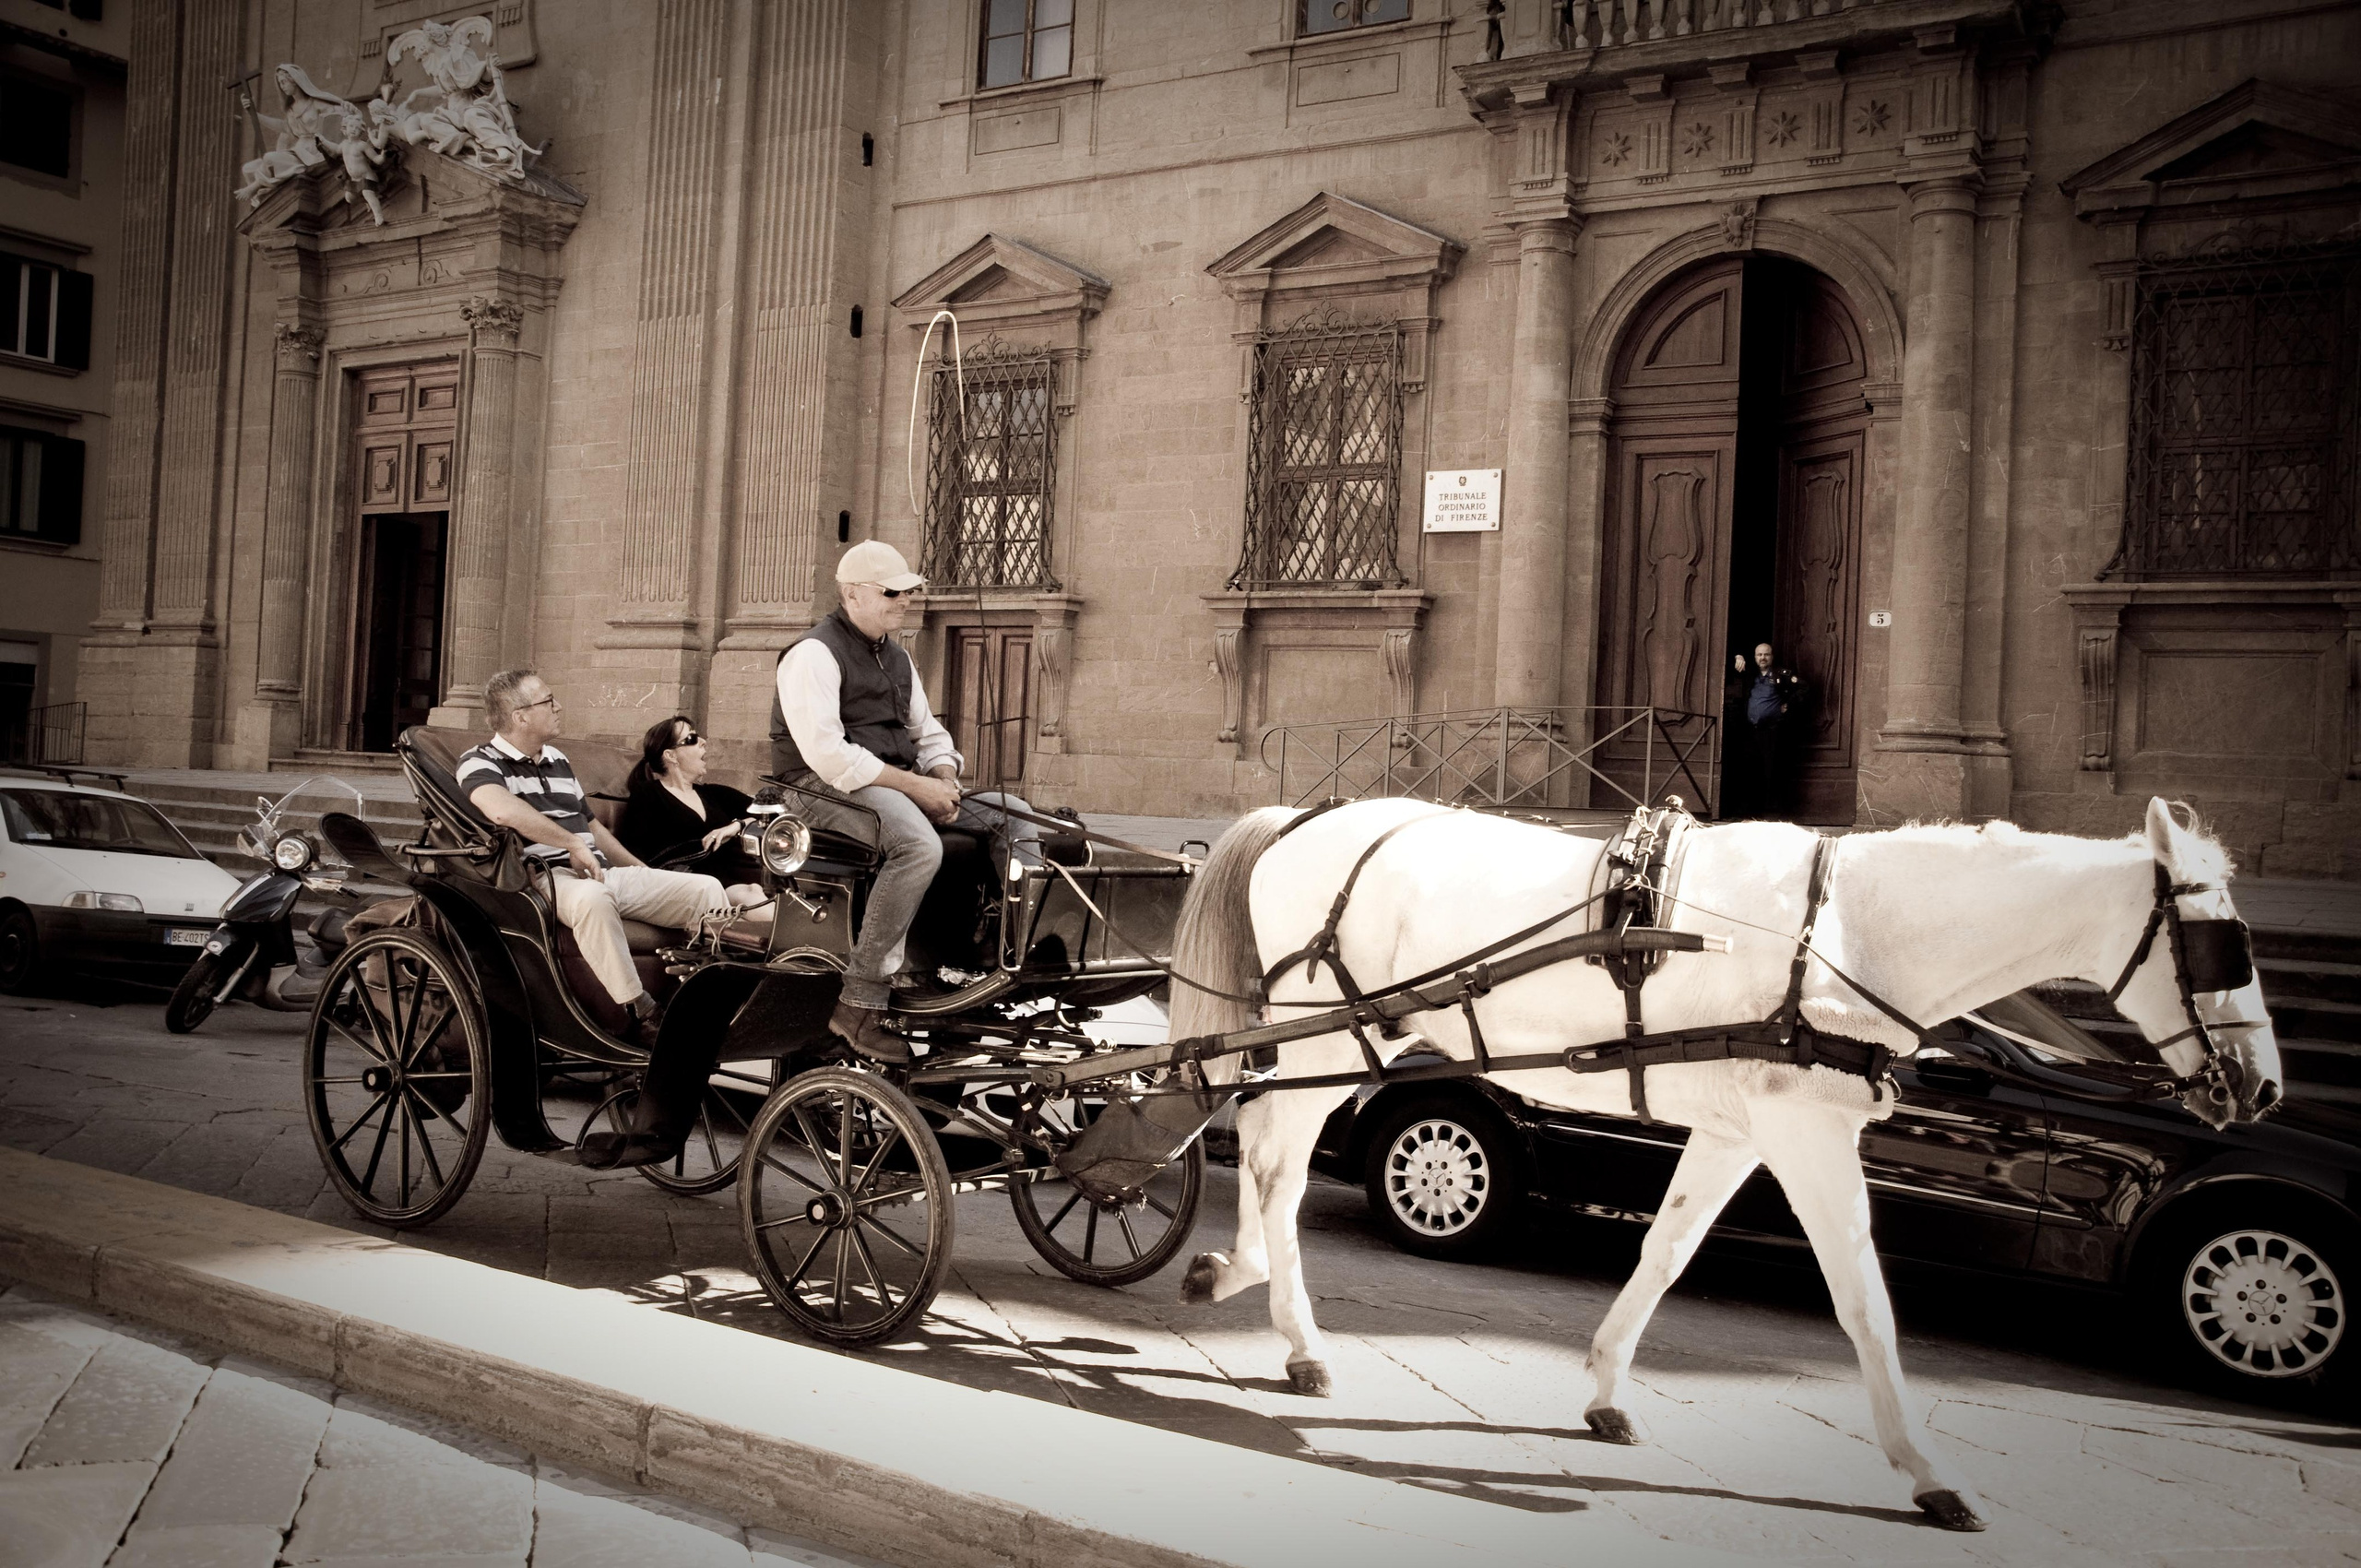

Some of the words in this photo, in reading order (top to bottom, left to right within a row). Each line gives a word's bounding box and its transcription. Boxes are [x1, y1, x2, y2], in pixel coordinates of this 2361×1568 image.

[1439, 492, 1487, 501] TRIBUNALE
[1438, 503, 1486, 511] ORDINARIO
[1451, 513, 1488, 521] FIRENZE
[1877, 613, 1884, 624] 5
